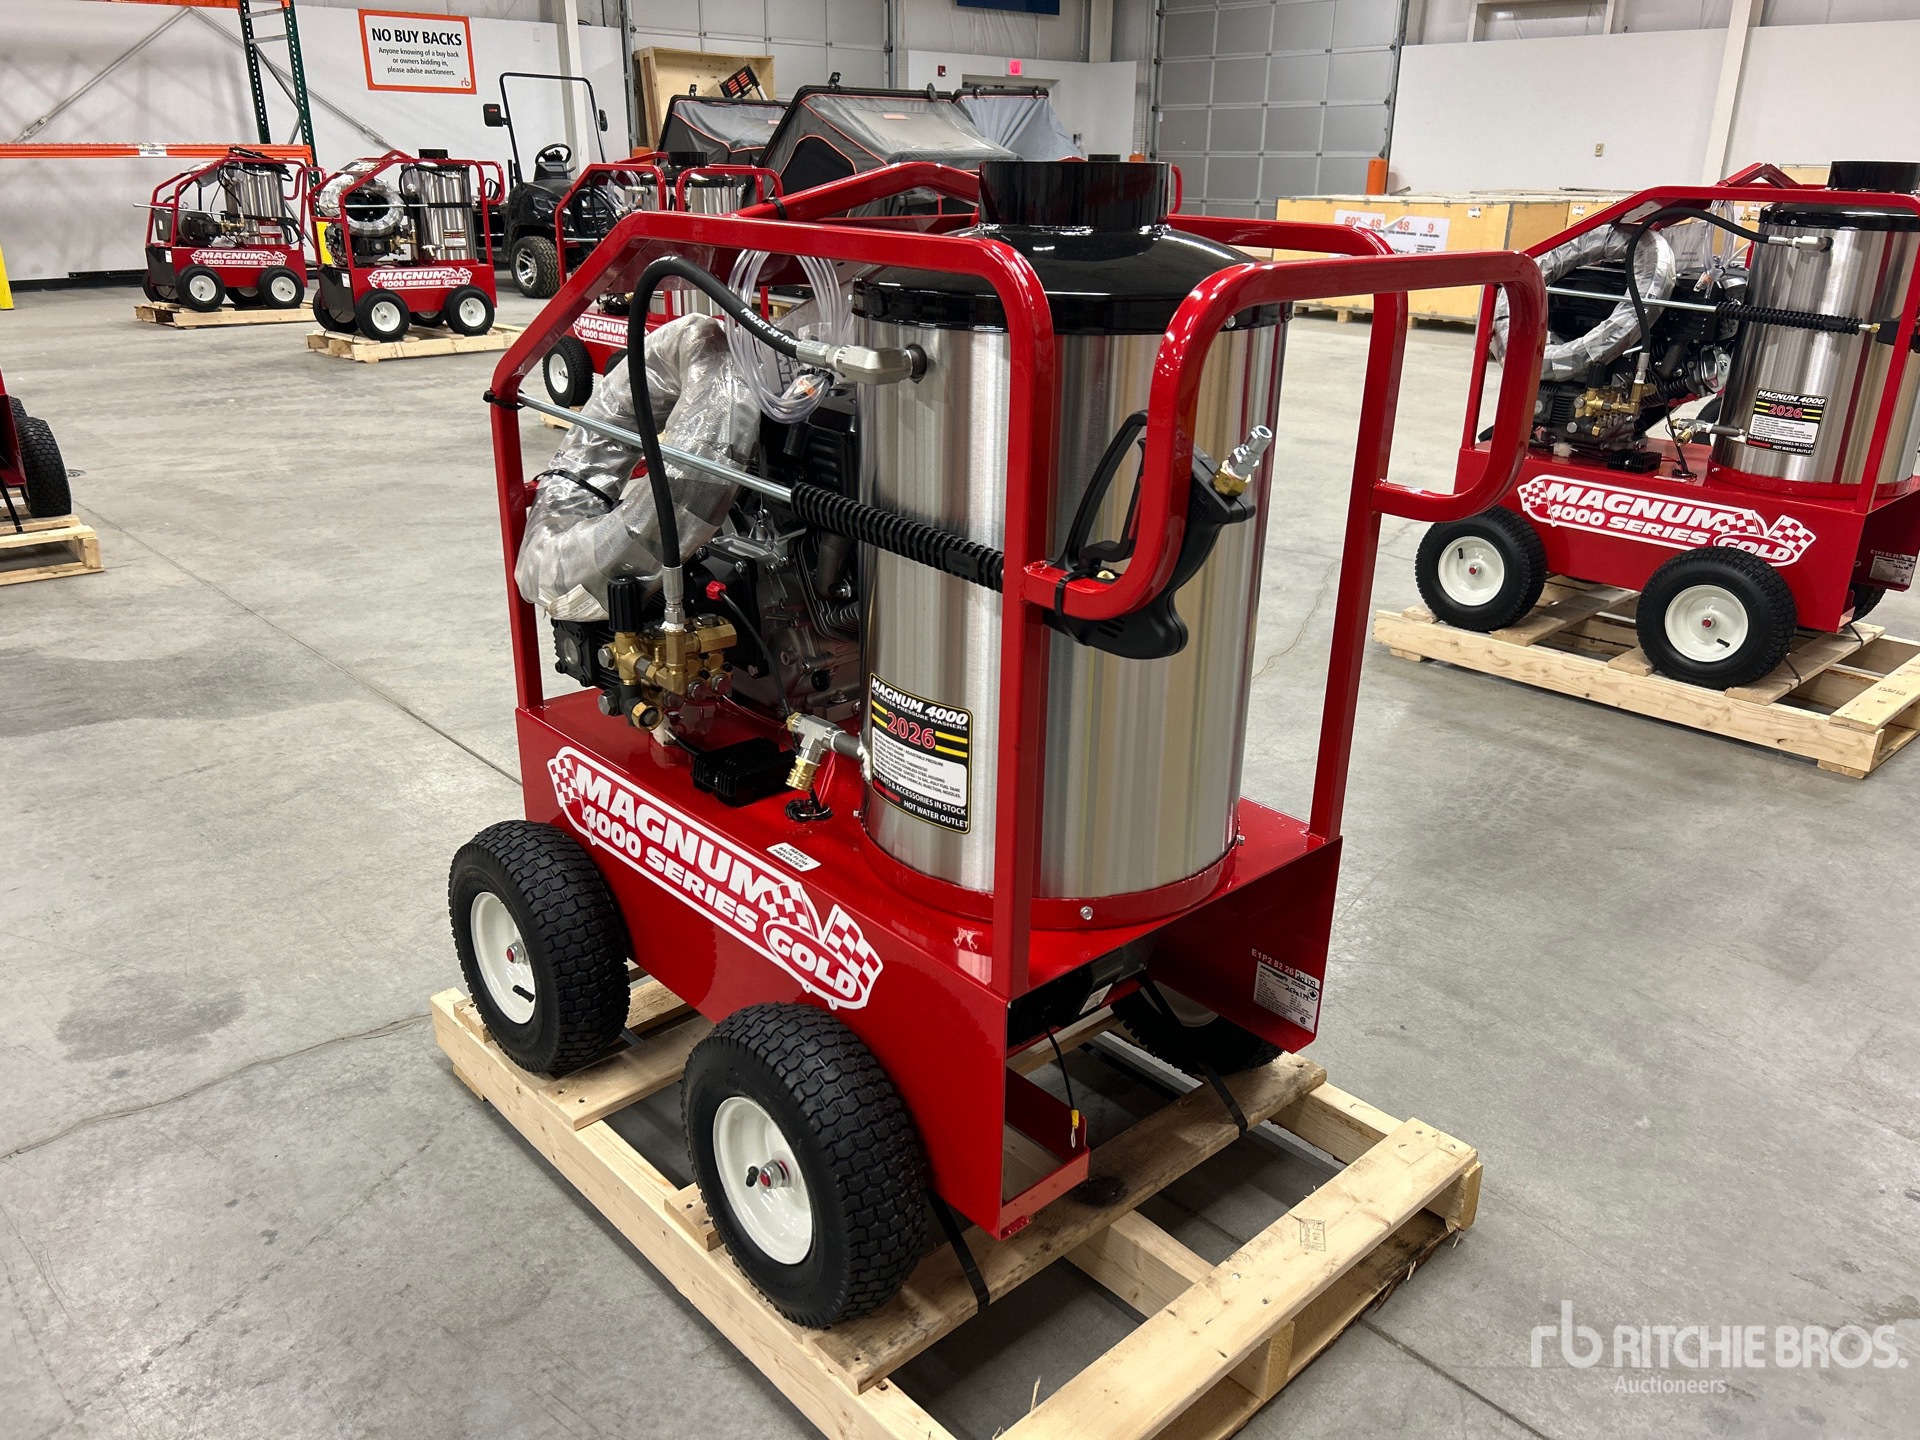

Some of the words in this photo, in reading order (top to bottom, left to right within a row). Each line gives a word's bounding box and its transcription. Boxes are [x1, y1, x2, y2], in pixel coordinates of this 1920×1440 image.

[372, 28, 391, 42] NO
[395, 30, 419, 43] BUY
[422, 32, 462, 46] BACKS
[379, 47, 399, 56] Anyone
[400, 48, 423, 57] knowing
[420, 58, 440, 67] bidding
[461, 77, 470, 86] rb
[1369, 218, 1382, 228] 48
[1398, 220, 1410, 231] 48
[1428, 223, 1434, 233] 9
[379, 271, 444, 280] MAGNUM
[580, 318, 628, 335] MAGNUM
[741, 308, 770, 330] PROJET
[767, 327, 783, 337] 3/8"
[582, 329, 598, 338] 4000
[599, 332, 625, 343] SERIES
[1758, 391, 1798, 402] MAGNUM
[1768, 404, 1803, 418] 2026
[1547, 483, 1724, 532] MAGNUM
[1547, 504, 1605, 526] 4000
[1607, 515, 1711, 545] SERIES
[1716, 537, 1790, 561] GOLD
[872, 677, 924, 713] MAGNUM
[925, 706, 968, 725] 4000
[880, 695, 896, 708] WATER
[897, 704, 929, 721] PRESSURE
[930, 716, 968, 731] WASHERS
[887, 711, 936, 749] 2026
[878, 773, 892, 787] PARTS
[892, 782, 896, 790] &
[896, 784, 933, 806] ACCESSORIES
[934, 800, 942, 810] IN
[943, 803, 966, 816] STOCK
[904, 800, 917, 812] HOT
[917, 805, 939, 819] WATER
[940, 814, 968, 828] OUTLET
[573, 763, 773, 910] MAGNUM
[772, 849, 804, 868] PREVENTER
[778, 847, 793, 856] BACK
[790, 848, 808, 860] INSTALL
[581, 804, 642, 858] 4000
[645, 846, 759, 933] SERIES
[768, 927, 859, 999] GOLD
[1252, 948, 1272, 964] E1P2
[1274, 960, 1283, 970] B2
[1285, 966, 1294, 975] 26
